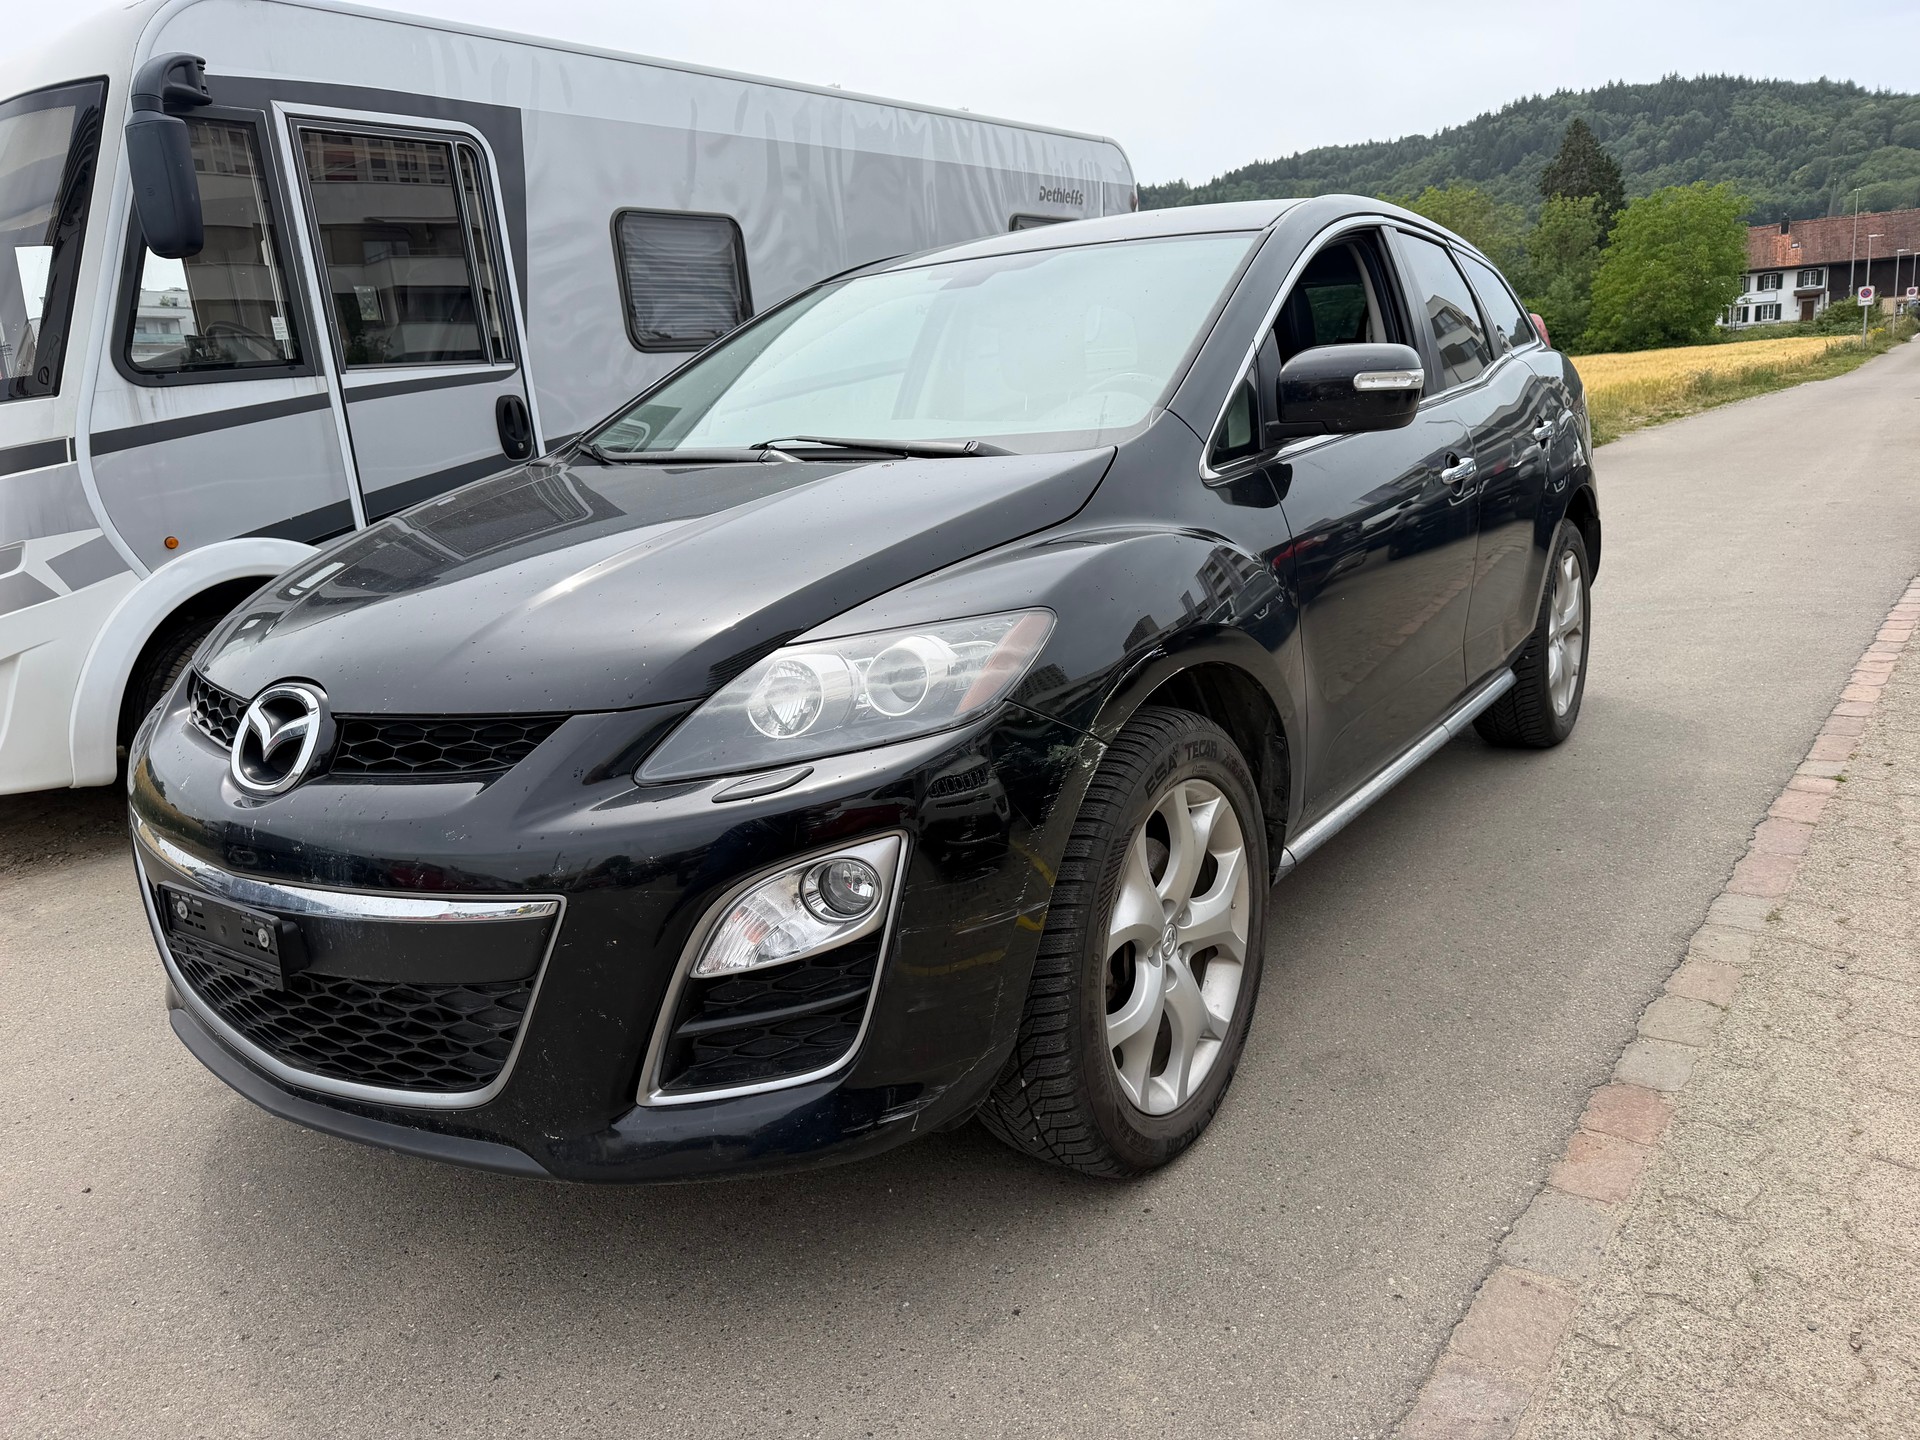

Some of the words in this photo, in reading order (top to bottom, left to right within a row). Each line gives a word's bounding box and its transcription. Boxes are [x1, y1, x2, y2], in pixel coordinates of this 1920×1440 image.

[1039, 185, 1084, 206] Dethleffs
[1184, 740, 1218, 761] TECAR
[1088, 952, 1100, 990] PRO
